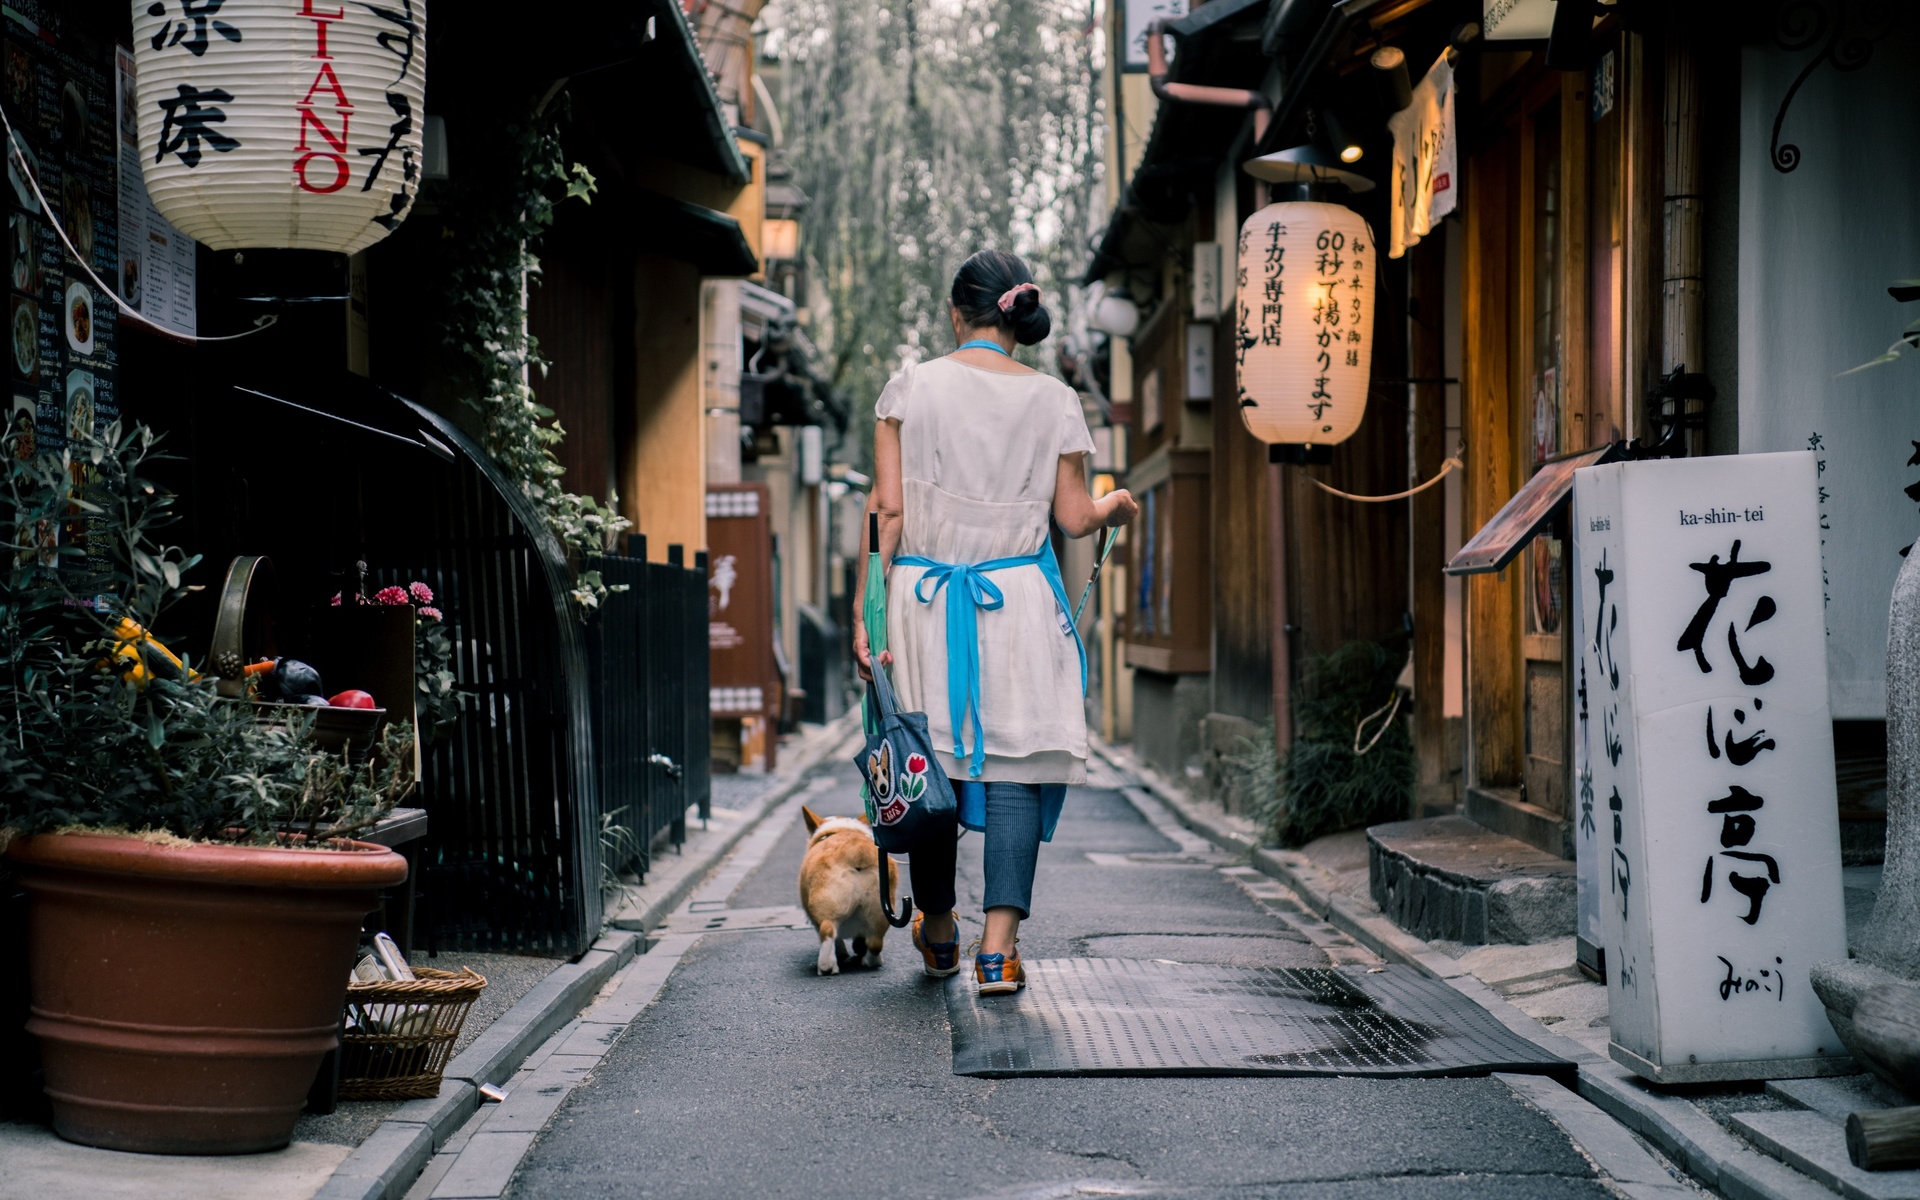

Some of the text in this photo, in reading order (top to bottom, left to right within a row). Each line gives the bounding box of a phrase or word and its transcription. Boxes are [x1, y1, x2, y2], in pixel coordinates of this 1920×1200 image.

[1261, 221, 1287, 347] 牛カツ専門店
[1307, 229, 1344, 433] 60秒で揚がります。
[1345, 237, 1365, 367] 和の牛カツ御膳
[1679, 506, 1764, 526] ka-shin-tei
[1676, 539, 1779, 925] 花心亭
